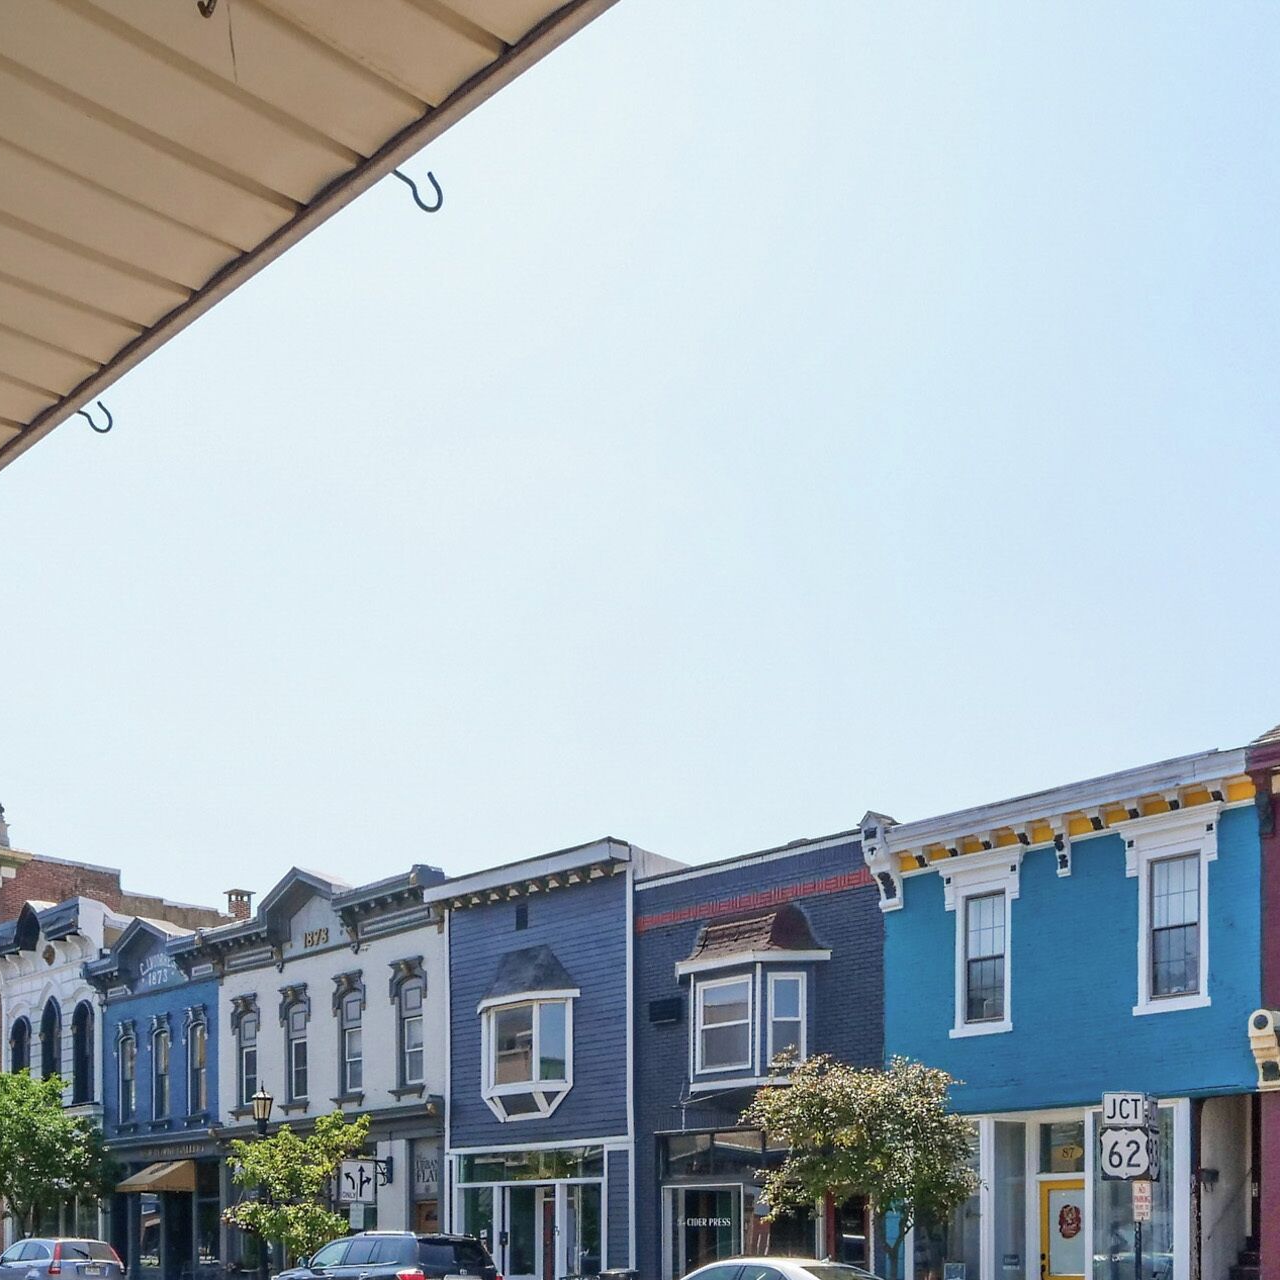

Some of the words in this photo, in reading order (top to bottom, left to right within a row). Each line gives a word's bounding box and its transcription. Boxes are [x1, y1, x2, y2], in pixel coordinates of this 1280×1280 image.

[1106, 1098, 1141, 1119] JCT
[1062, 1147, 1075, 1159] 87
[1108, 1140, 1141, 1168] 62
[686, 1217, 707, 1227] CIDER
[708, 1217, 731, 1227] PRESS
